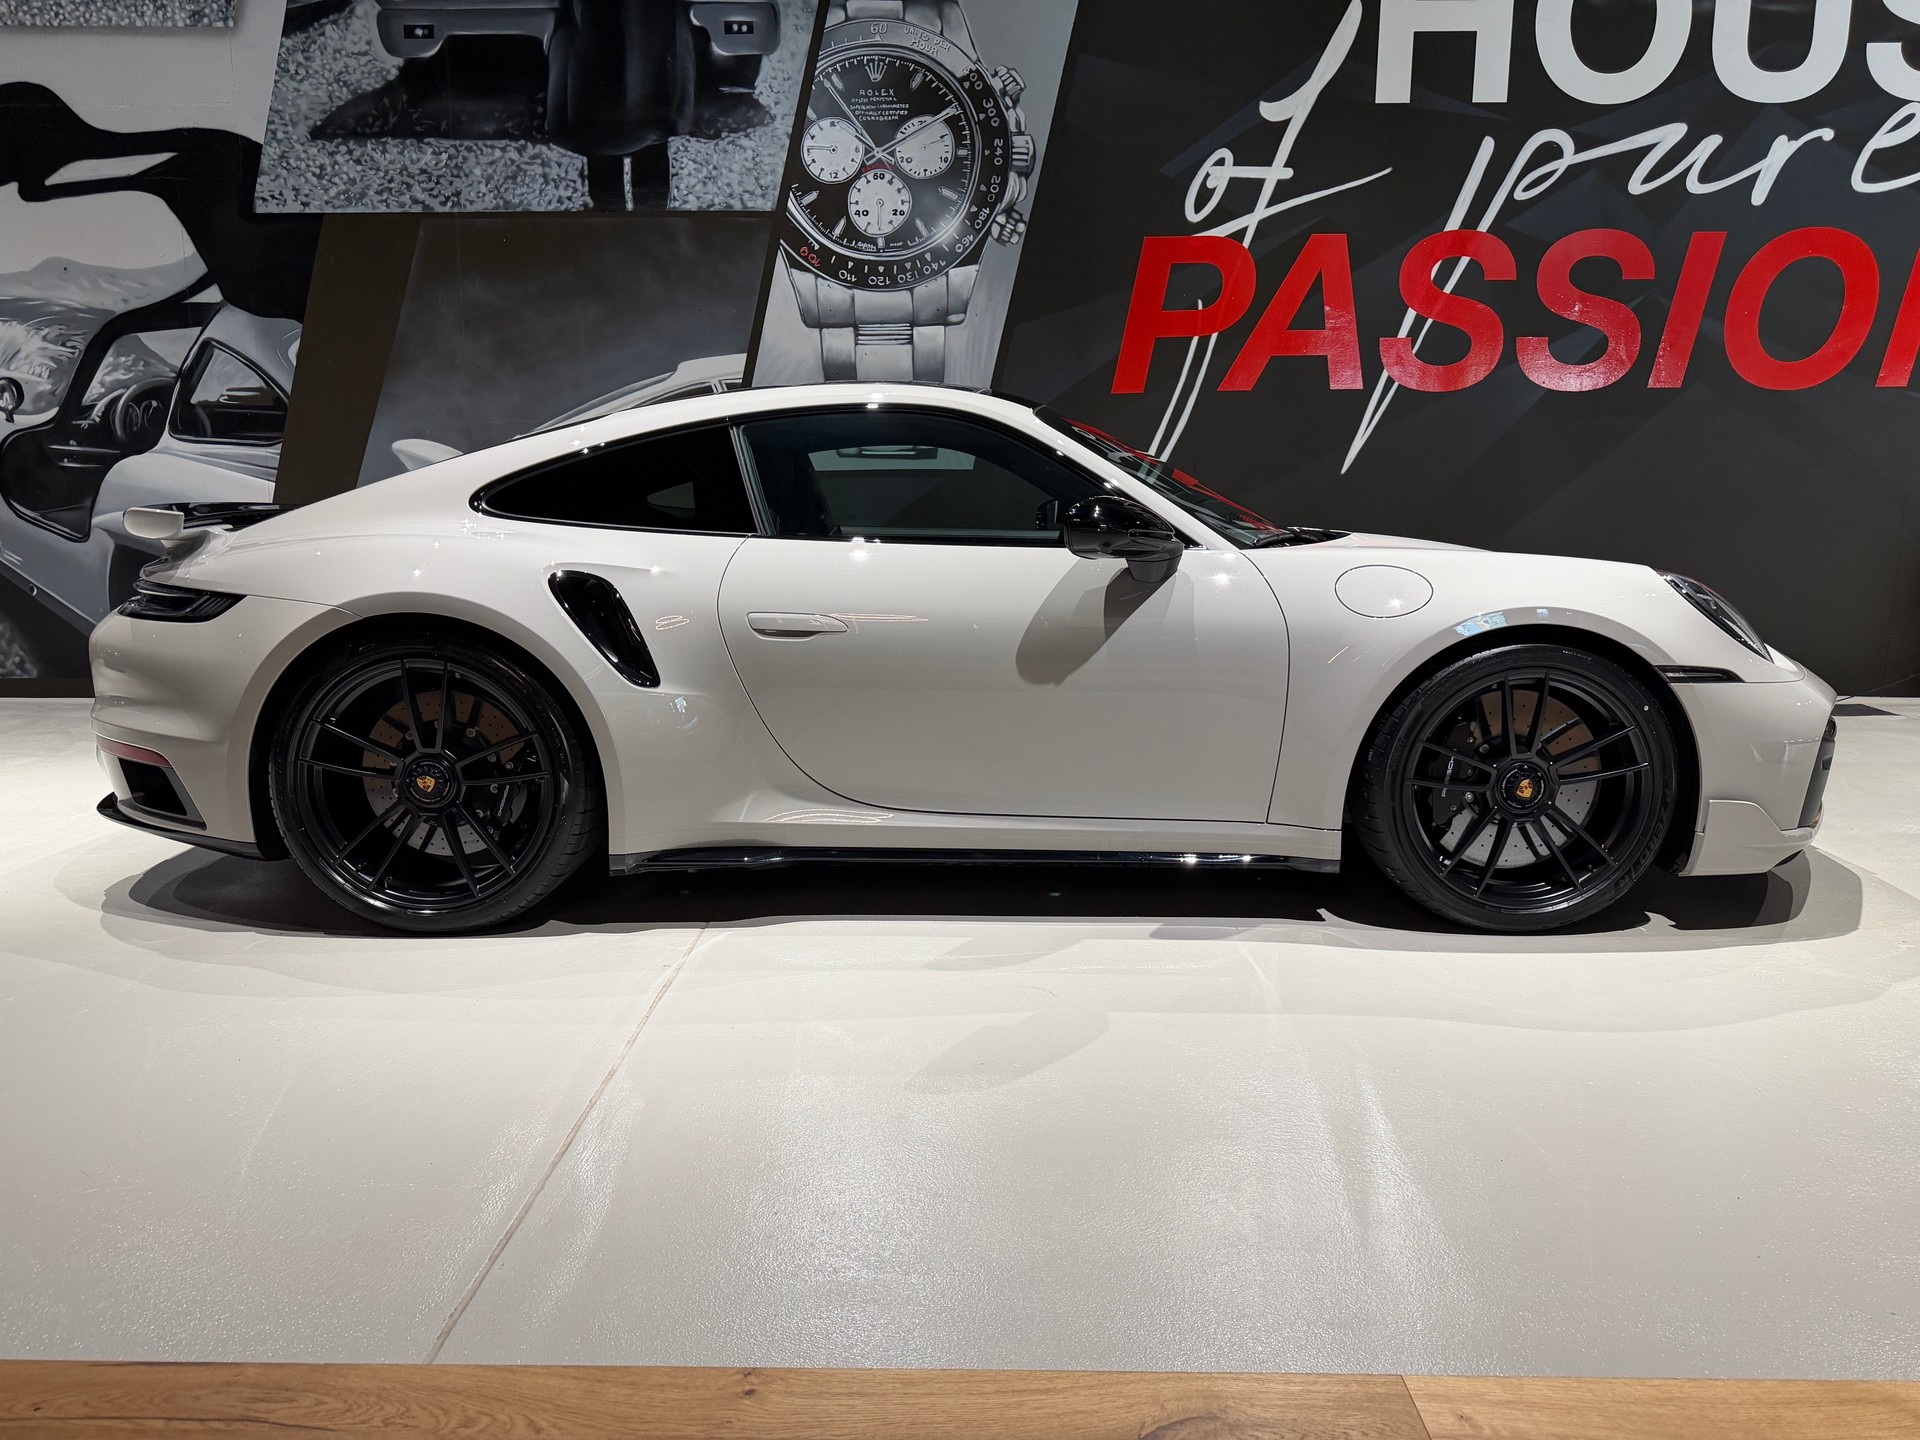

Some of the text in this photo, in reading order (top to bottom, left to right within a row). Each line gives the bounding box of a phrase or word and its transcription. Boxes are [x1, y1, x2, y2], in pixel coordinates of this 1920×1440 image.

[870, 22, 888, 35] 60
[904, 26, 951, 52] UNITS PER
[911, 38, 938, 56] HOUR
[1375, 0, 1920, 104] HOU
[859, 88, 895, 97] ROLEX
[982, 98, 1000, 127] 300
[939, 155, 949, 163] 10
[993, 138, 1004, 166] 240
[829, 171, 839, 179] 12
[872, 172, 886, 181] 60
[987, 175, 1002, 202] 200
[854, 208, 906, 218] 40 20
[974, 206, 990, 230] 180
[955, 234, 974, 253] 160
[923, 259, 946, 275] 140
[838, 269, 858, 283] 110
[868, 275, 891, 286] 120
[897, 270, 920, 284] 130
[1111, 226, 1920, 394] PASSIO
